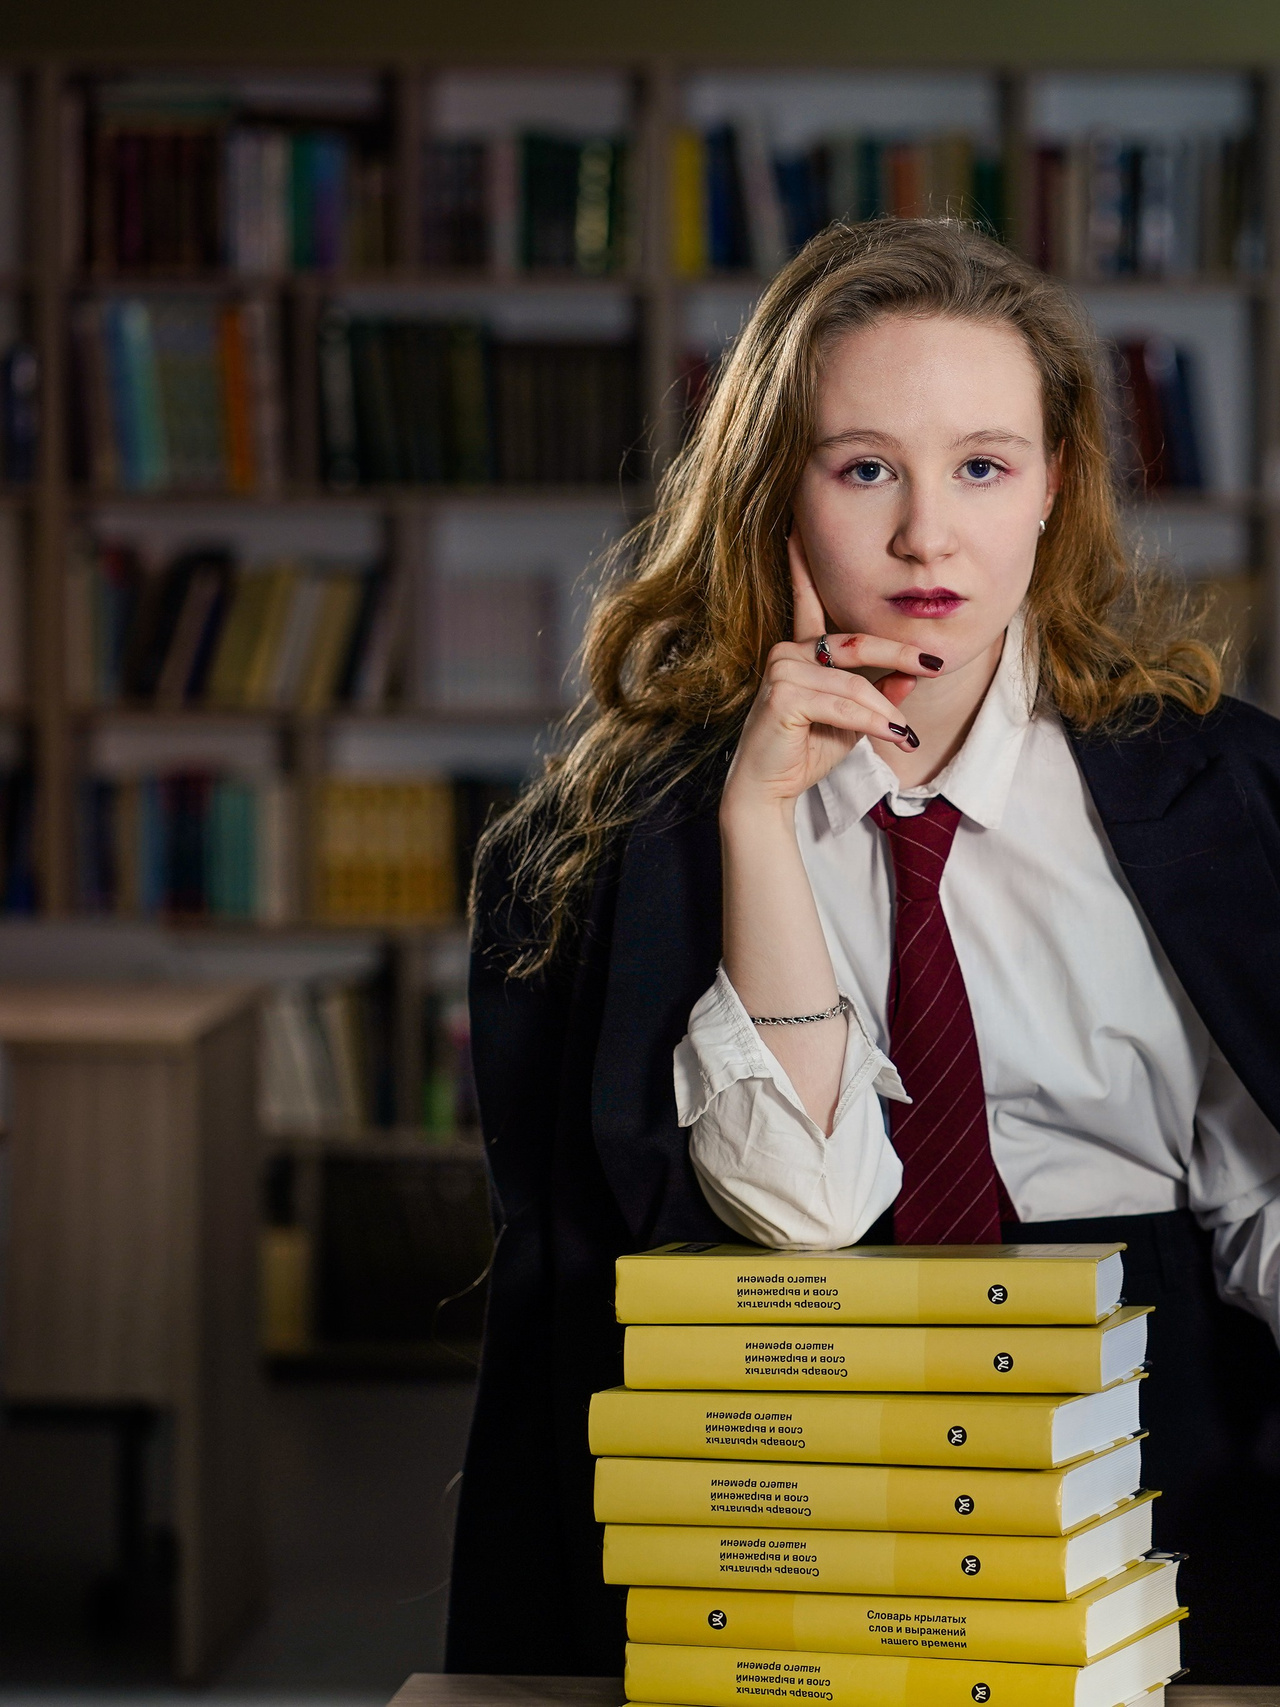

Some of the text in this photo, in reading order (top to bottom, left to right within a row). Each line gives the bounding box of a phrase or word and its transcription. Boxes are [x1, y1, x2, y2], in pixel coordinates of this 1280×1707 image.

[736, 1273, 827, 1284] нашего времени
[736, 1286, 839, 1298] слов и выражений
[736, 1298, 842, 1311] Словарь крылатых
[745, 1340, 835, 1351] нашего времени
[744, 1353, 846, 1365] слов и выражений
[744, 1365, 849, 1378] Словарь крылатых
[705, 1410, 793, 1422] нашего времени
[705, 1423, 804, 1435] слов и выражений
[705, 1435, 806, 1449] Словарь крылатых
[710, 1477, 799, 1490] нашего времени
[710, 1491, 810, 1503] слов и выражений
[710, 1503, 812, 1517] Словарь крылатых
[720, 1538, 807, 1550] нашего времени
[719, 1551, 818, 1563] слов и выражений
[719, 1563, 820, 1578] Словарь крылатых
[866, 1609, 967, 1625] Словарь крылатых
[868, 1624, 967, 1637] слов и выражений
[880, 1637, 968, 1649] нашего времени
[736, 1661, 821, 1674] нашего времени
[735, 1674, 831, 1687] слов и выражений
[735, 1686, 834, 1702] Словарь крылатых
